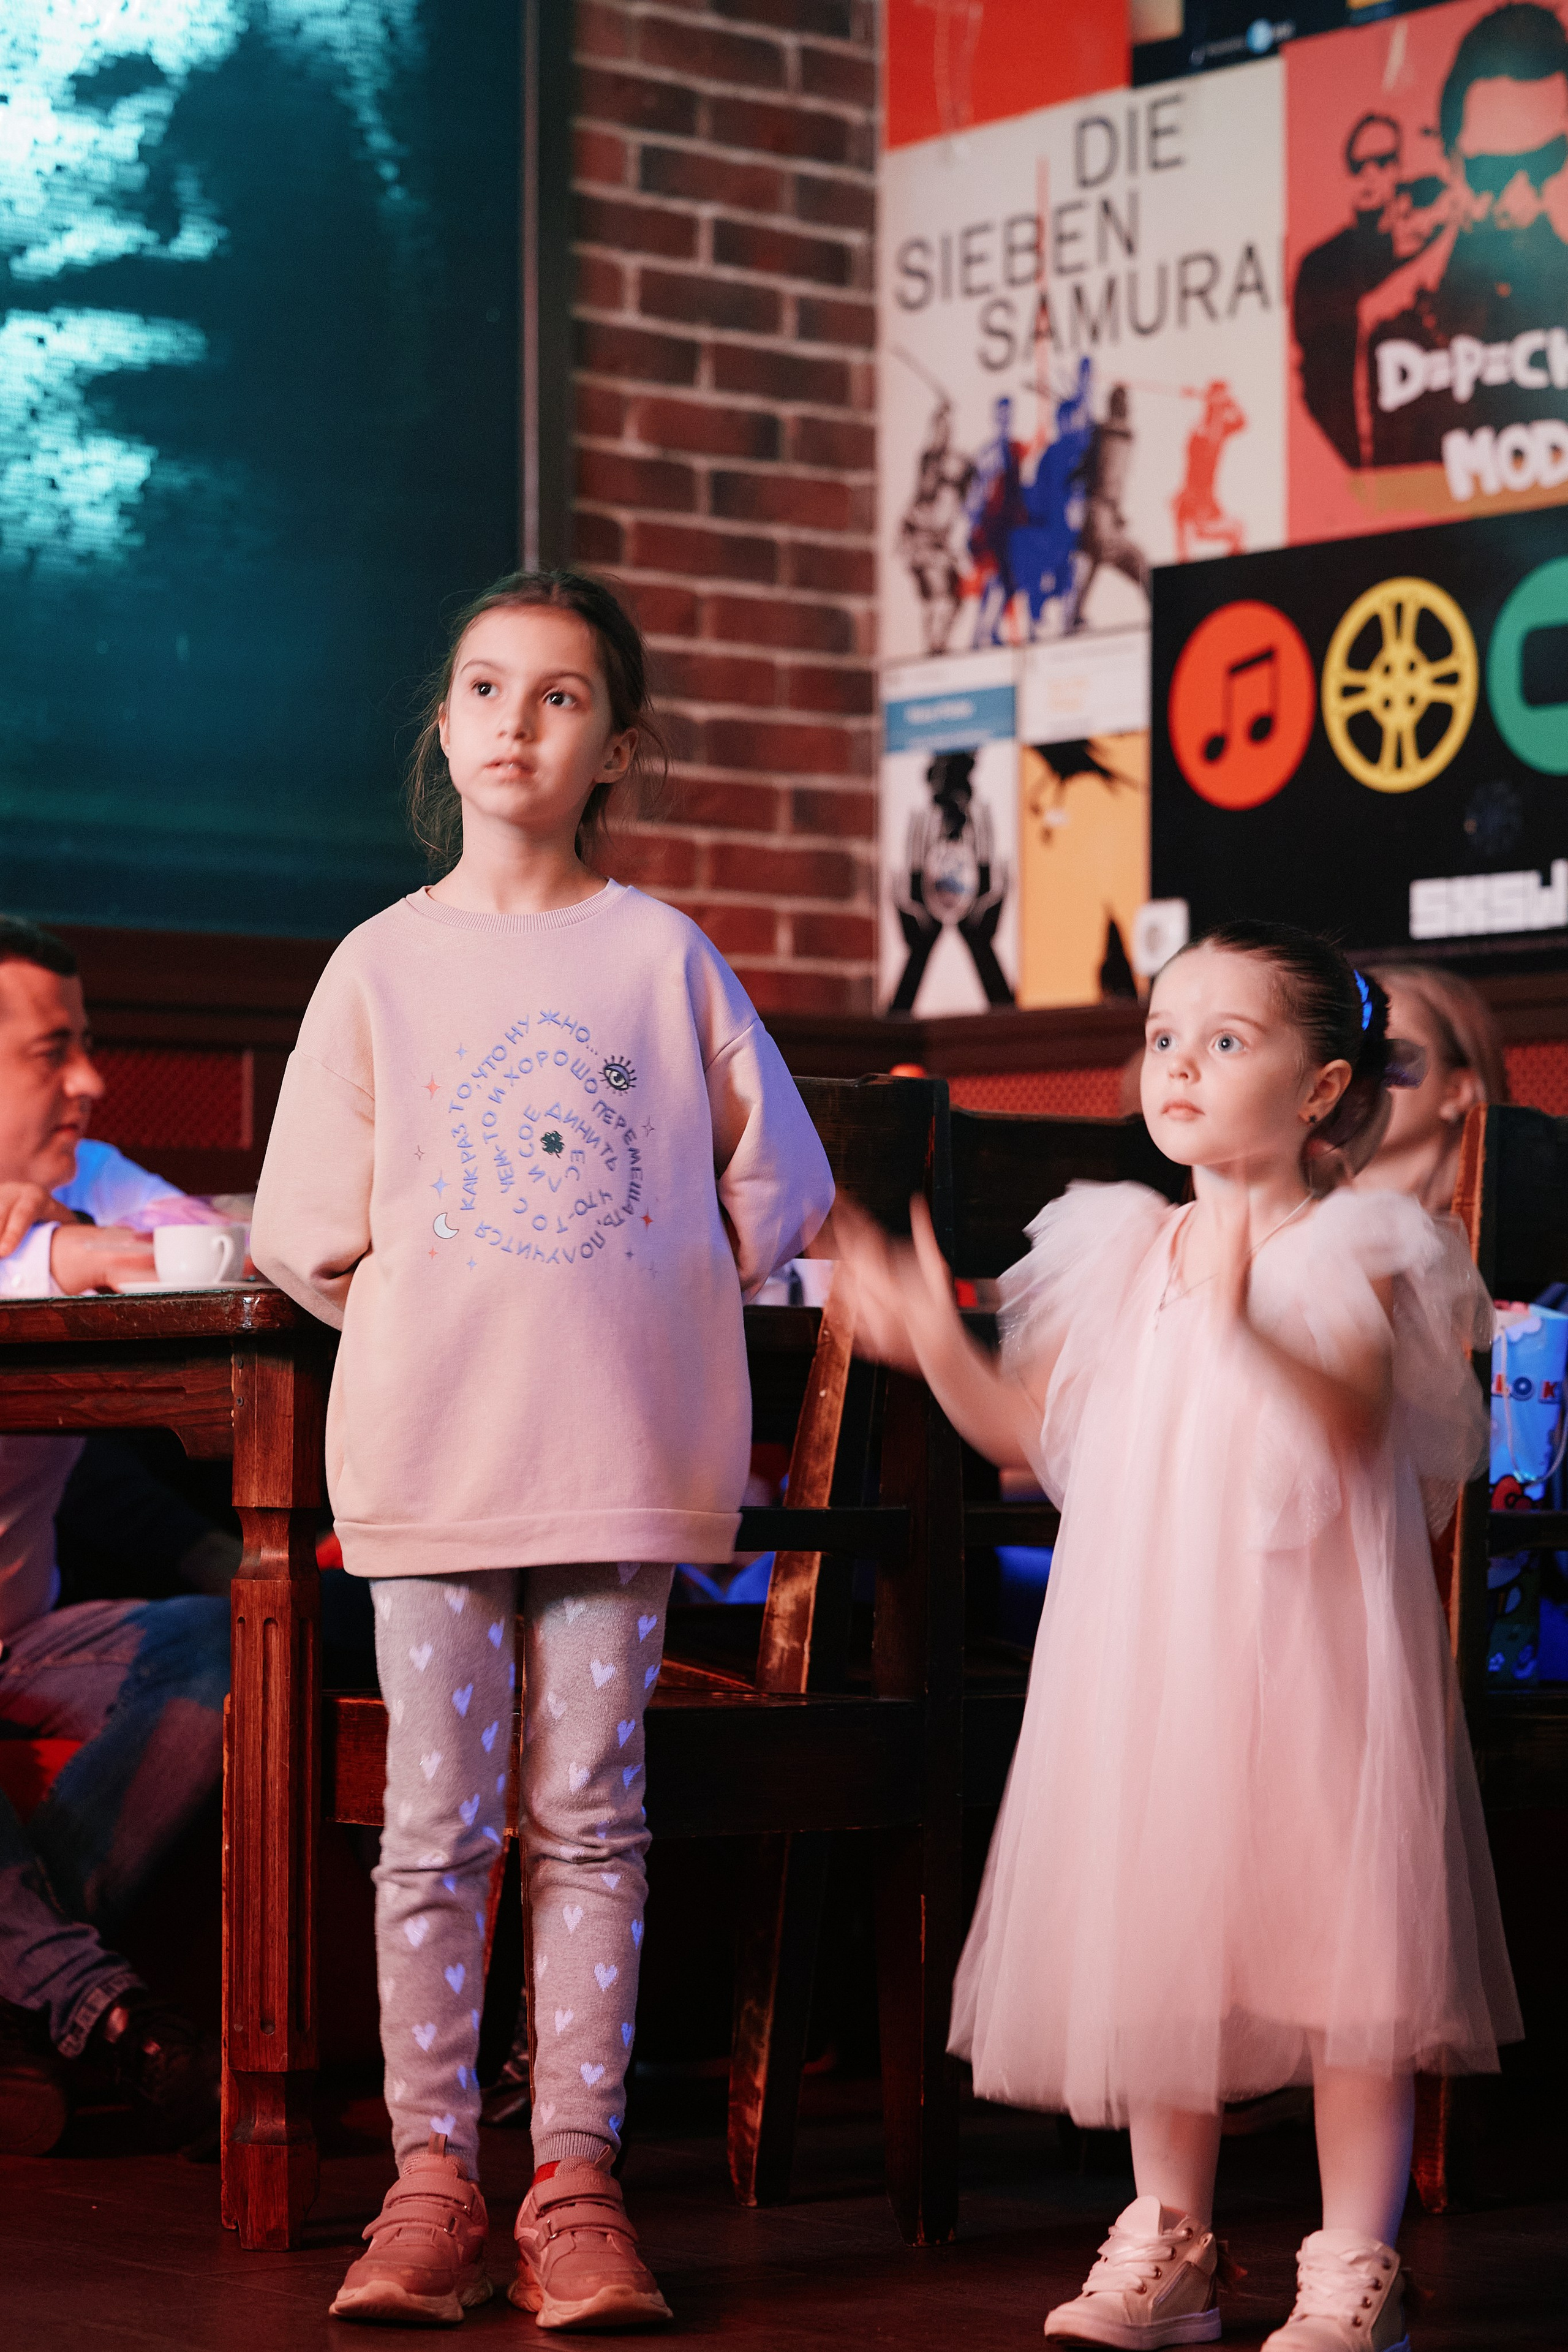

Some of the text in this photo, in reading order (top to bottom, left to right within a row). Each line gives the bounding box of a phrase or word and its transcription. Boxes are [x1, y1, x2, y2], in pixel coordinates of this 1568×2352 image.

[1074, 92, 1186, 189] DIE
[894, 187, 1140, 314] SIEBEN
[470, 1044, 507, 1079] ЧТО
[503, 1049, 598, 1094] ХОРОШО
[488, 1087, 507, 1104] И
[451, 1123, 477, 1164] РАЗ
[519, 1102, 618, 1171] СОЕДИНИТЬ
[460, 1166, 478, 1210] КАК
[529, 1149, 585, 1192] ЕСЛИ
[513, 1197, 529, 1214] С
[474, 1220, 606, 1264] ПОЛУЧИТСЯ
